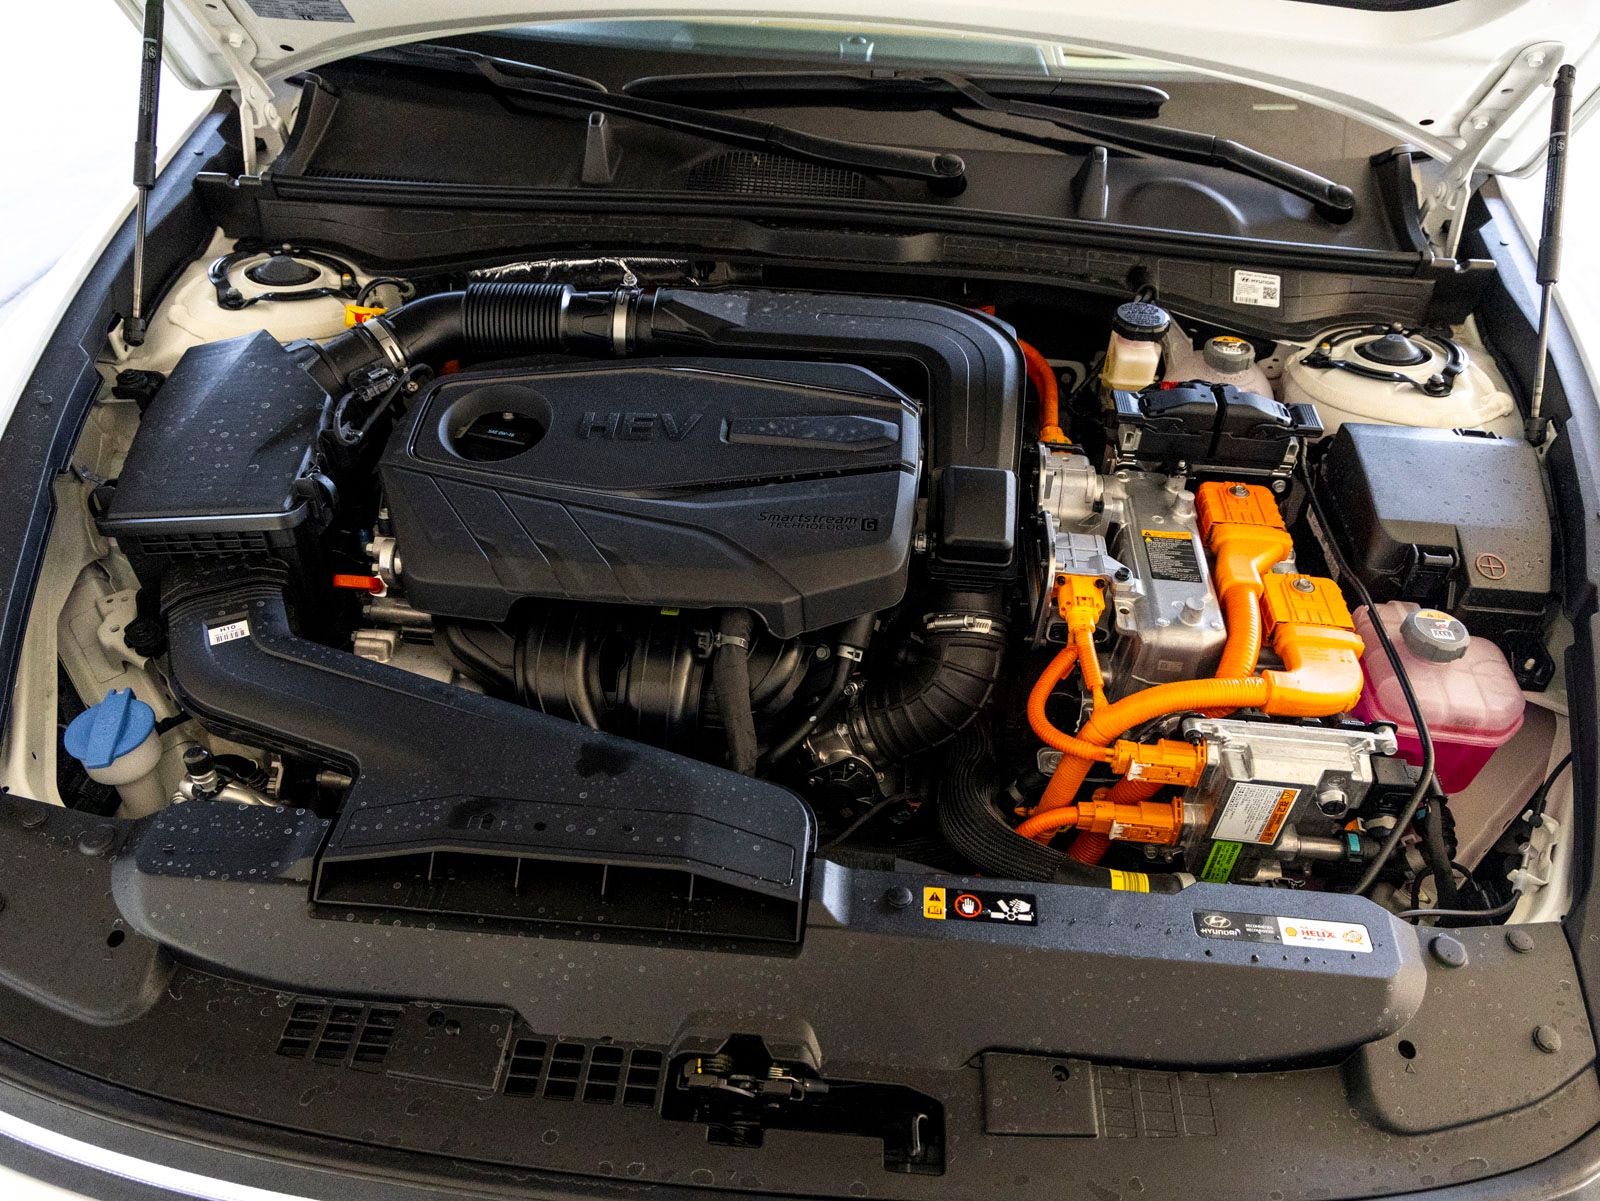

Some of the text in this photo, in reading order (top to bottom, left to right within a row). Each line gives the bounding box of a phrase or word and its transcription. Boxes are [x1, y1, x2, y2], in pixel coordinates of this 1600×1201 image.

[580, 411, 703, 440] HEV
[759, 511, 857, 524] Smartstream
[769, 521, 853, 530] TECHNOLOGY
[1201, 928, 1242, 937] HYUNDAI
[1302, 929, 1336, 938] HELIX
